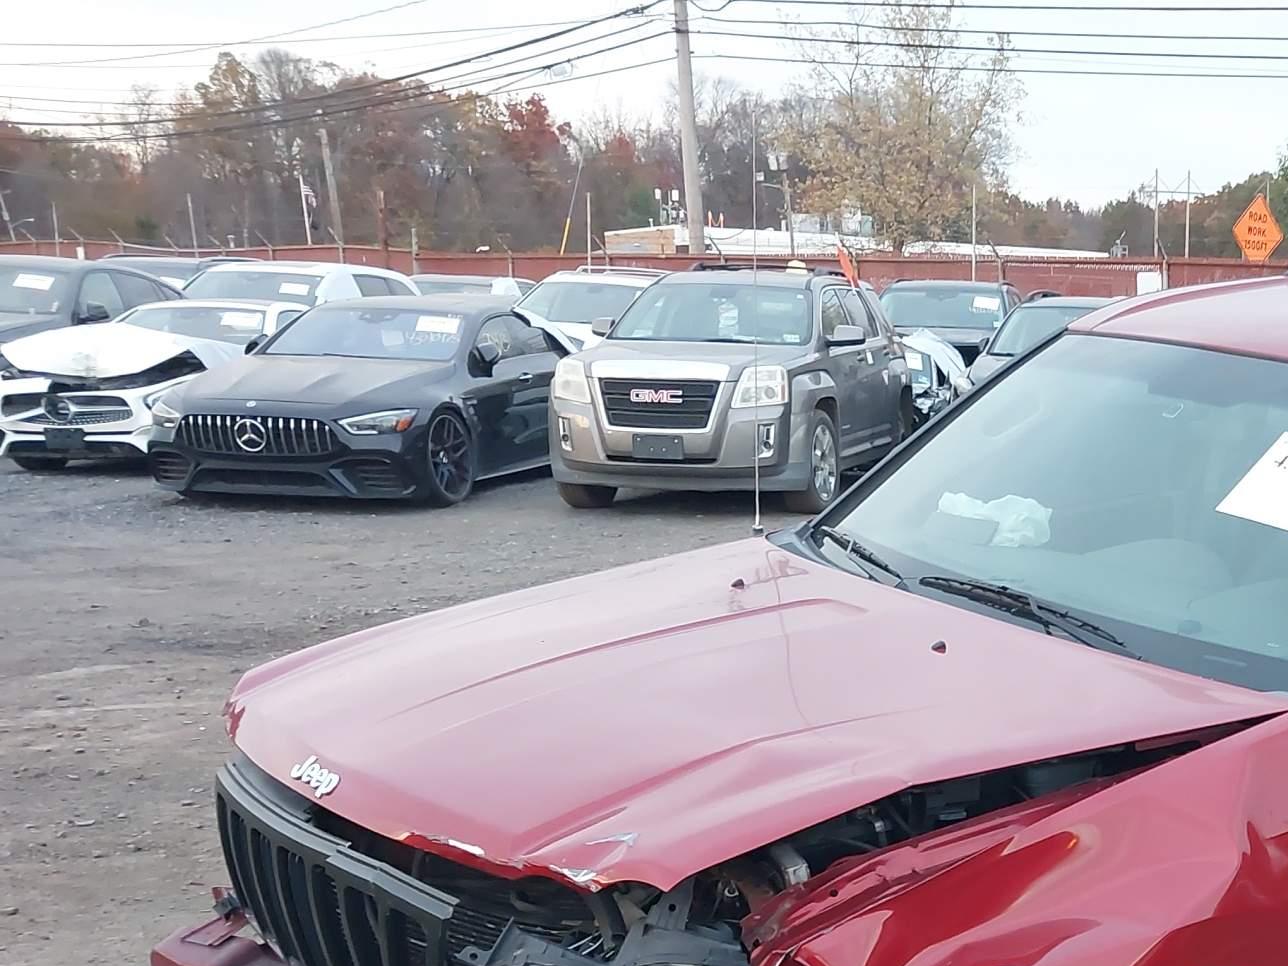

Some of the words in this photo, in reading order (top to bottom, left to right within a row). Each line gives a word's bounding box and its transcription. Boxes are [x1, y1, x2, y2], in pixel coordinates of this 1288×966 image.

[1248, 211, 1268, 223] ROAD
[1247, 226, 1267, 237] WORK
[630, 388, 684, 404] GMC
[290, 755, 341, 800] Jeep
